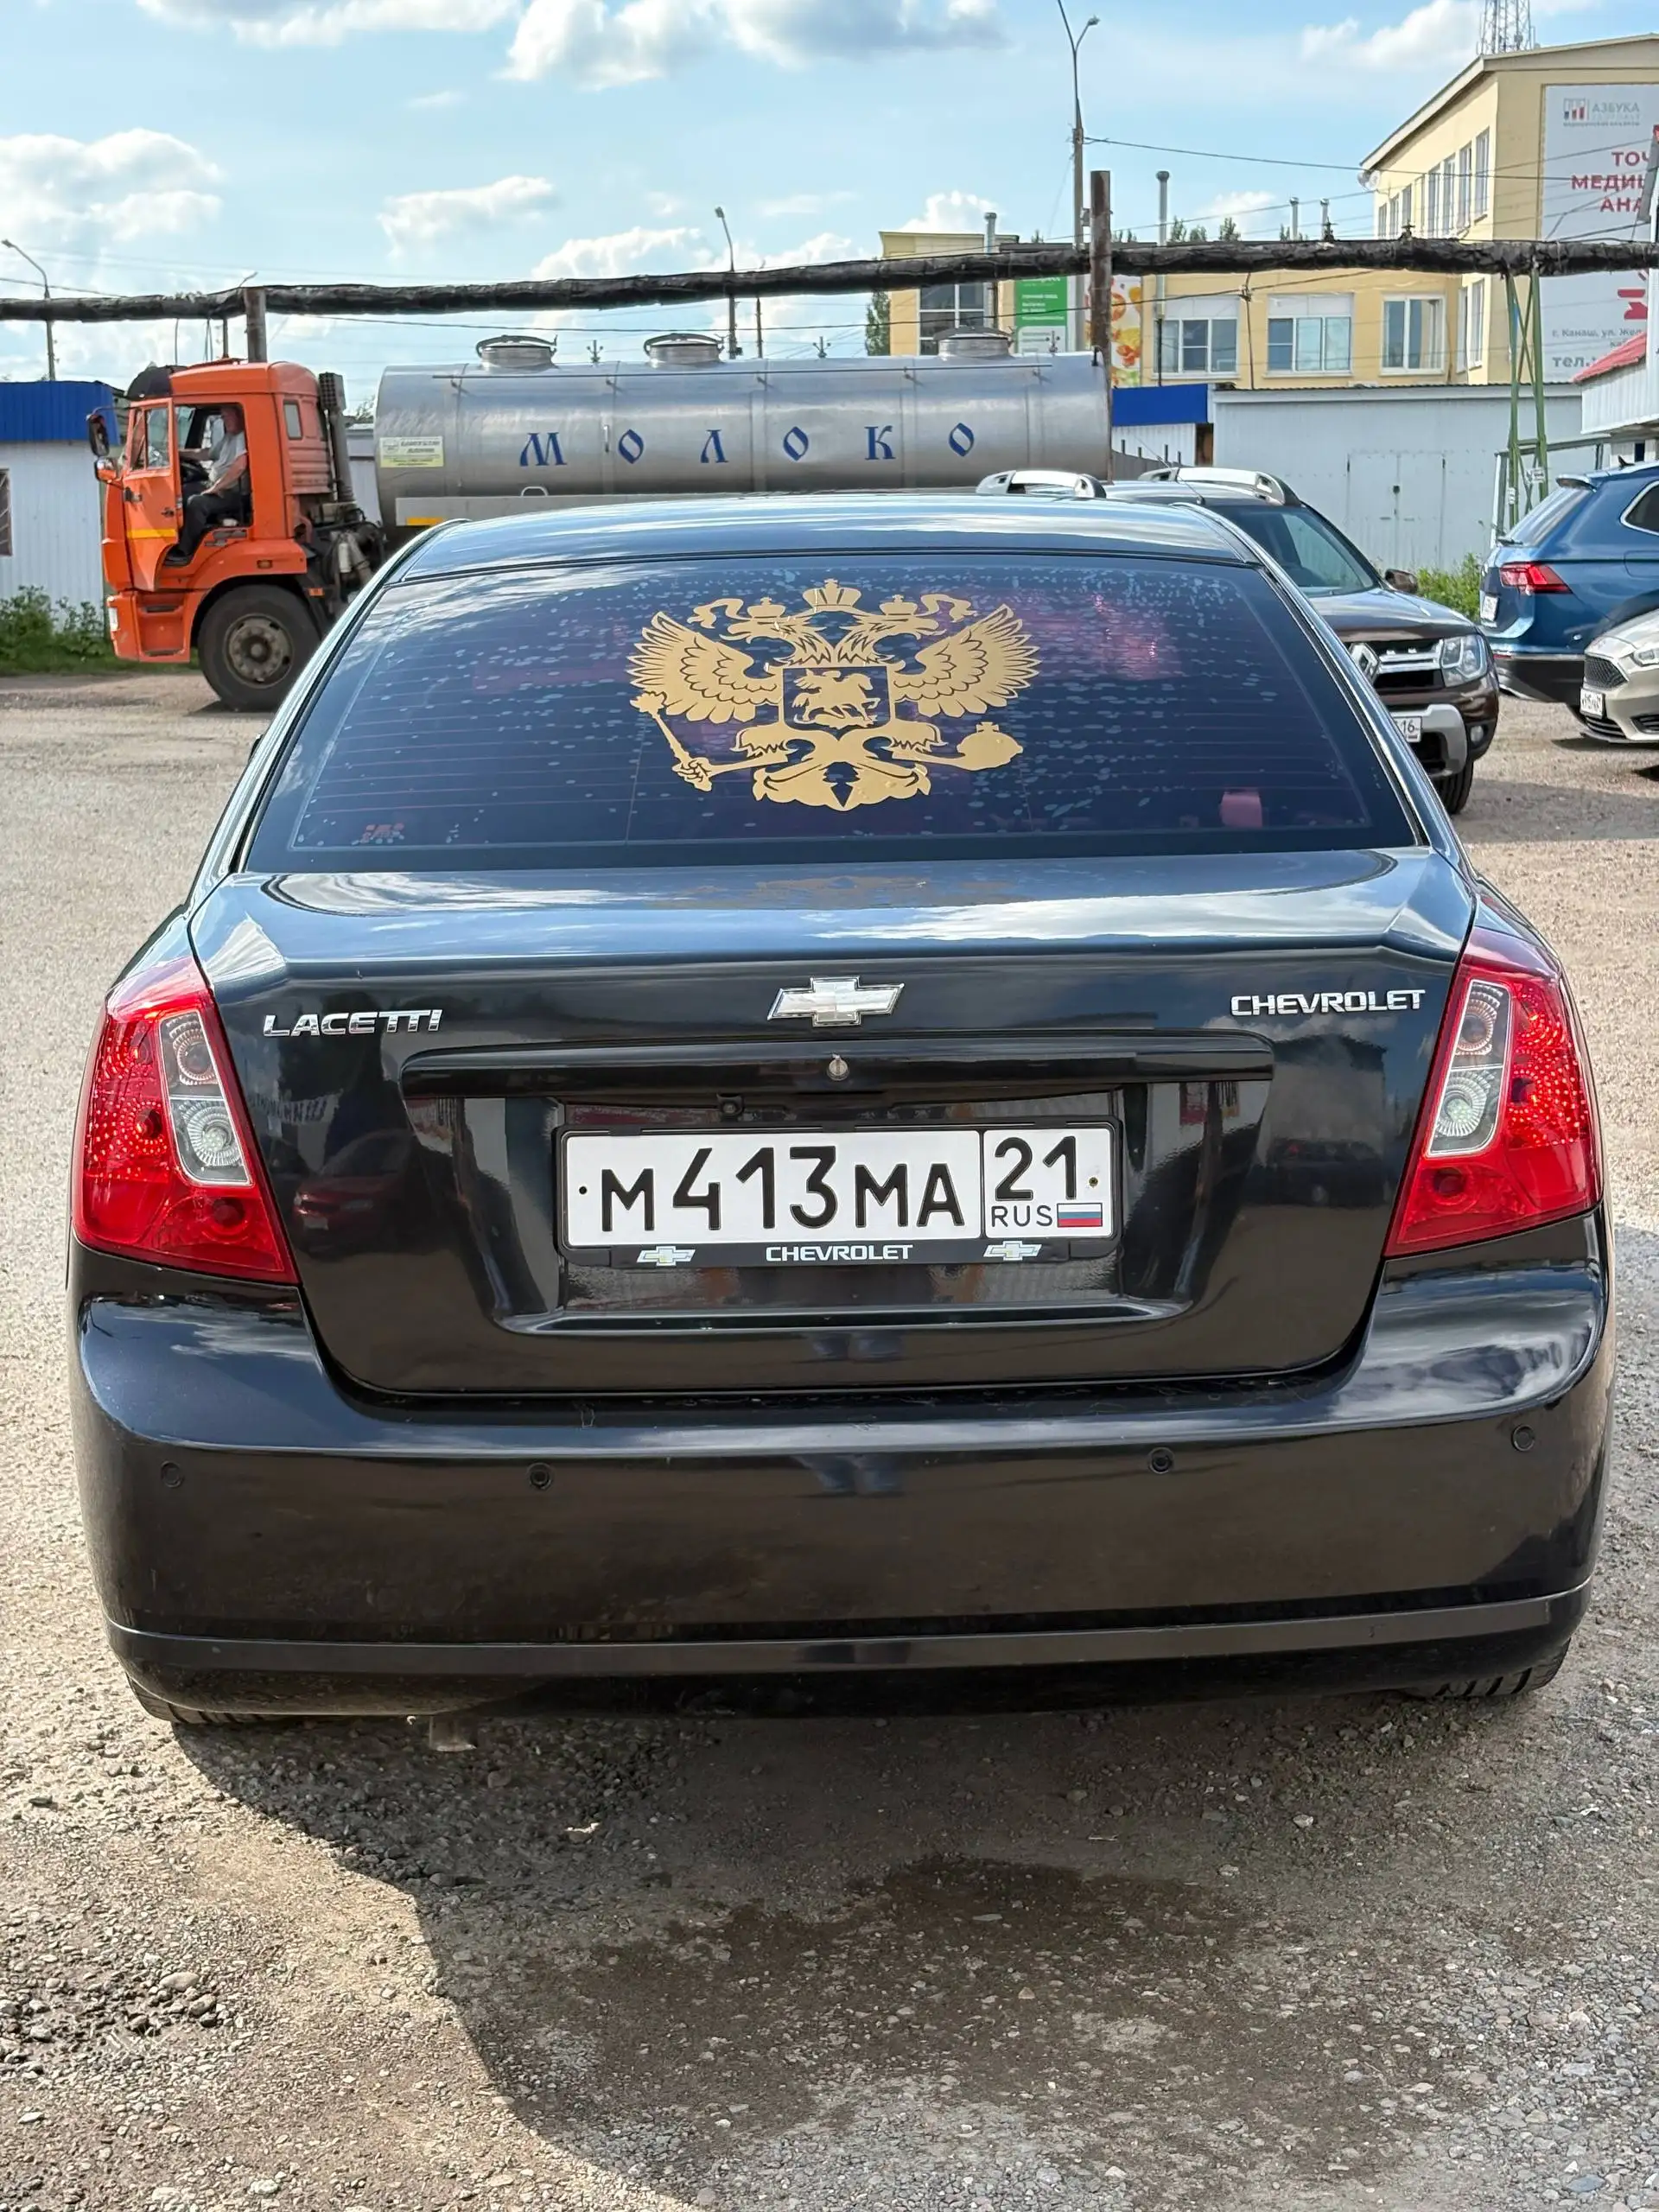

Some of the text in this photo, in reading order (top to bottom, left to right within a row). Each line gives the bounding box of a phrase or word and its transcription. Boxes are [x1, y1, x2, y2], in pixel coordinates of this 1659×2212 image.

[1592, 102, 1640, 113] АЗБУКА
[519, 422, 976, 467] МОЛОКО
[1230, 989, 1426, 1016] CHEVROLET
[263, 1009, 442, 1037] LACETTI
[601, 1135, 1077, 1232] М413МА 21
[990, 1205, 1053, 1228] RUS
[766, 1243, 913, 1262] CHEVROLET
